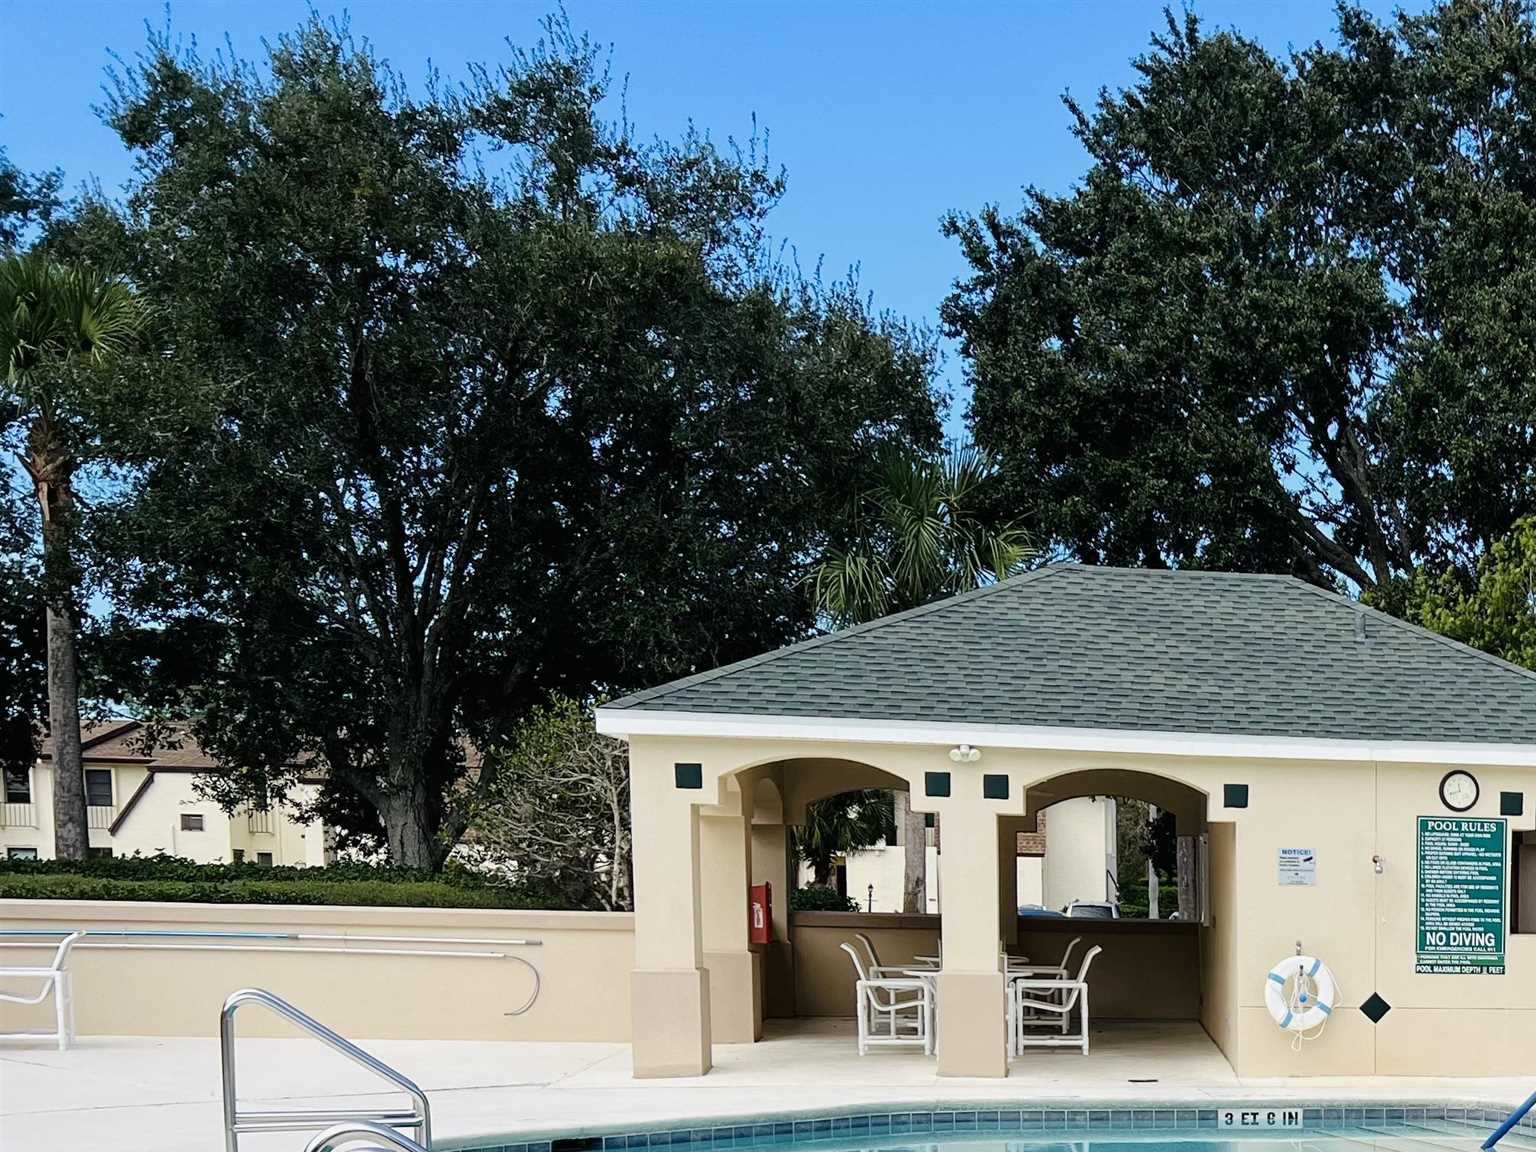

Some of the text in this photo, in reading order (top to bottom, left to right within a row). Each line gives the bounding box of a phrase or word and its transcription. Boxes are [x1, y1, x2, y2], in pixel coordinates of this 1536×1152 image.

[1427, 821, 1497, 832] POOL RULES
[1426, 931, 1495, 946] NO DIVING
[1416, 965, 1430, 973] POOL
[1433, 965, 1461, 973] MAXIMUM
[1461, 966, 1481, 974] DEPTH
